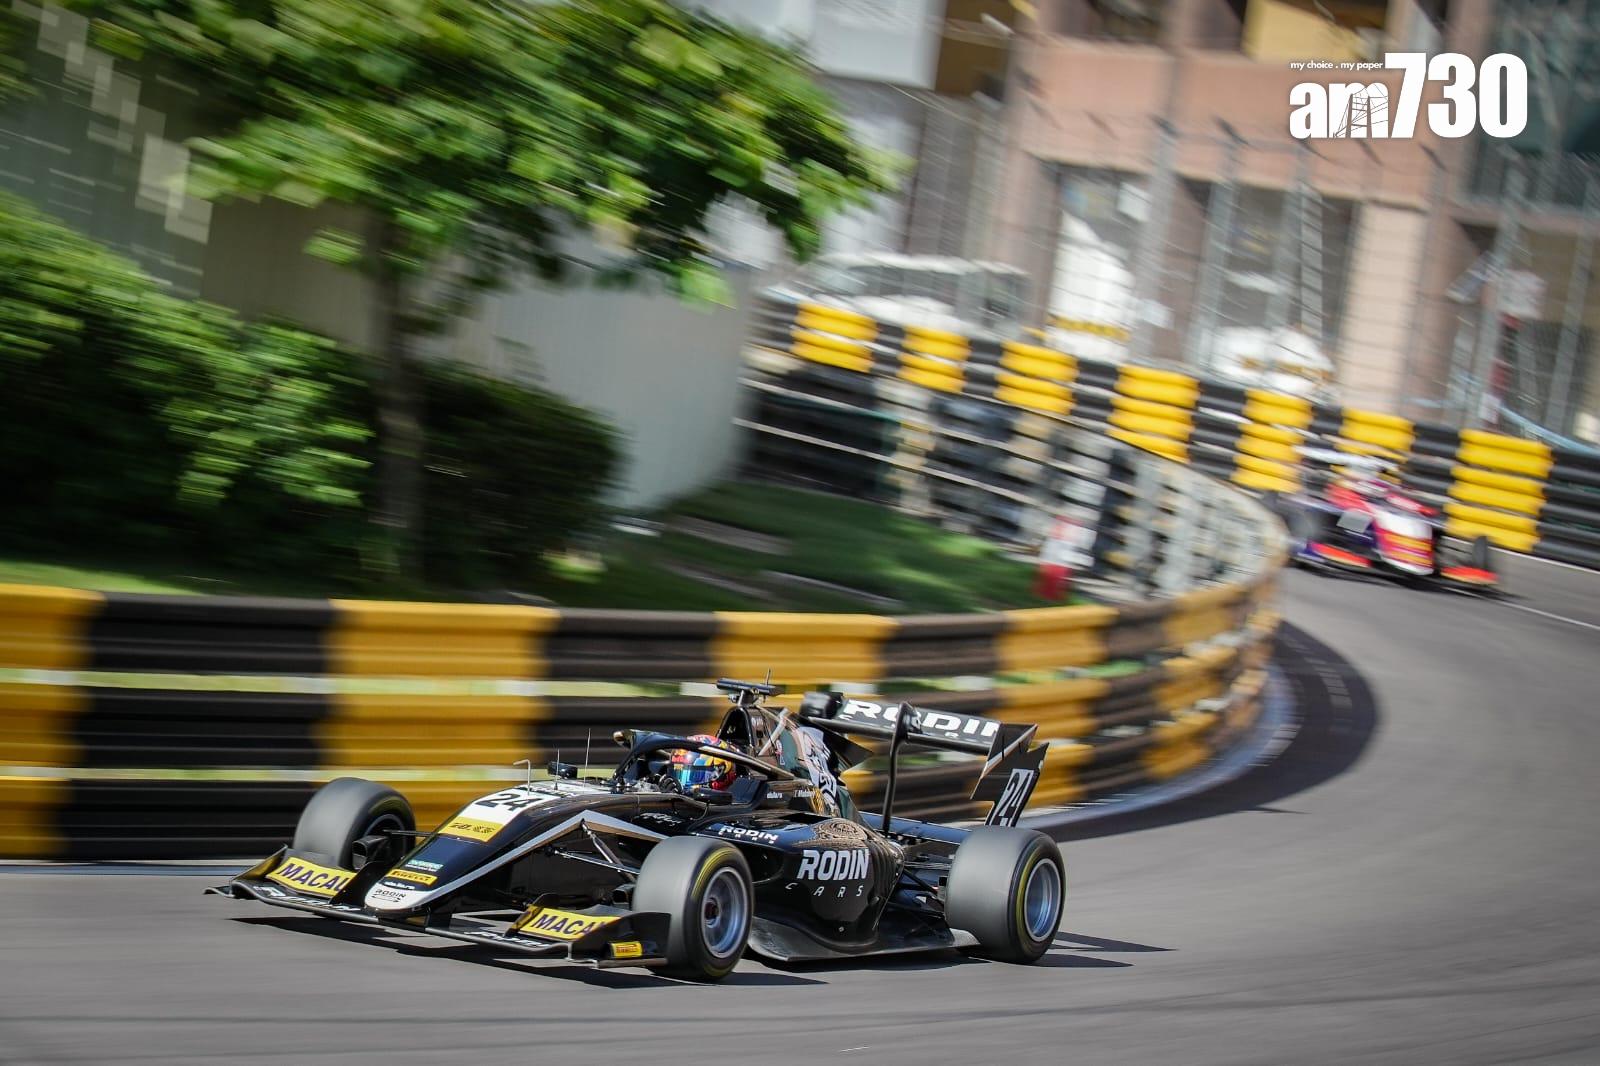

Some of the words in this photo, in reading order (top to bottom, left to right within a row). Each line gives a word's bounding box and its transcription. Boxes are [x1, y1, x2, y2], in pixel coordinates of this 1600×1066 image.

[474, 791, 544, 813] 24
[989, 769, 1033, 827] 24
[720, 824, 779, 842] RODIN
[796, 848, 870, 882] RODIN
[785, 881, 865, 898] CARS
